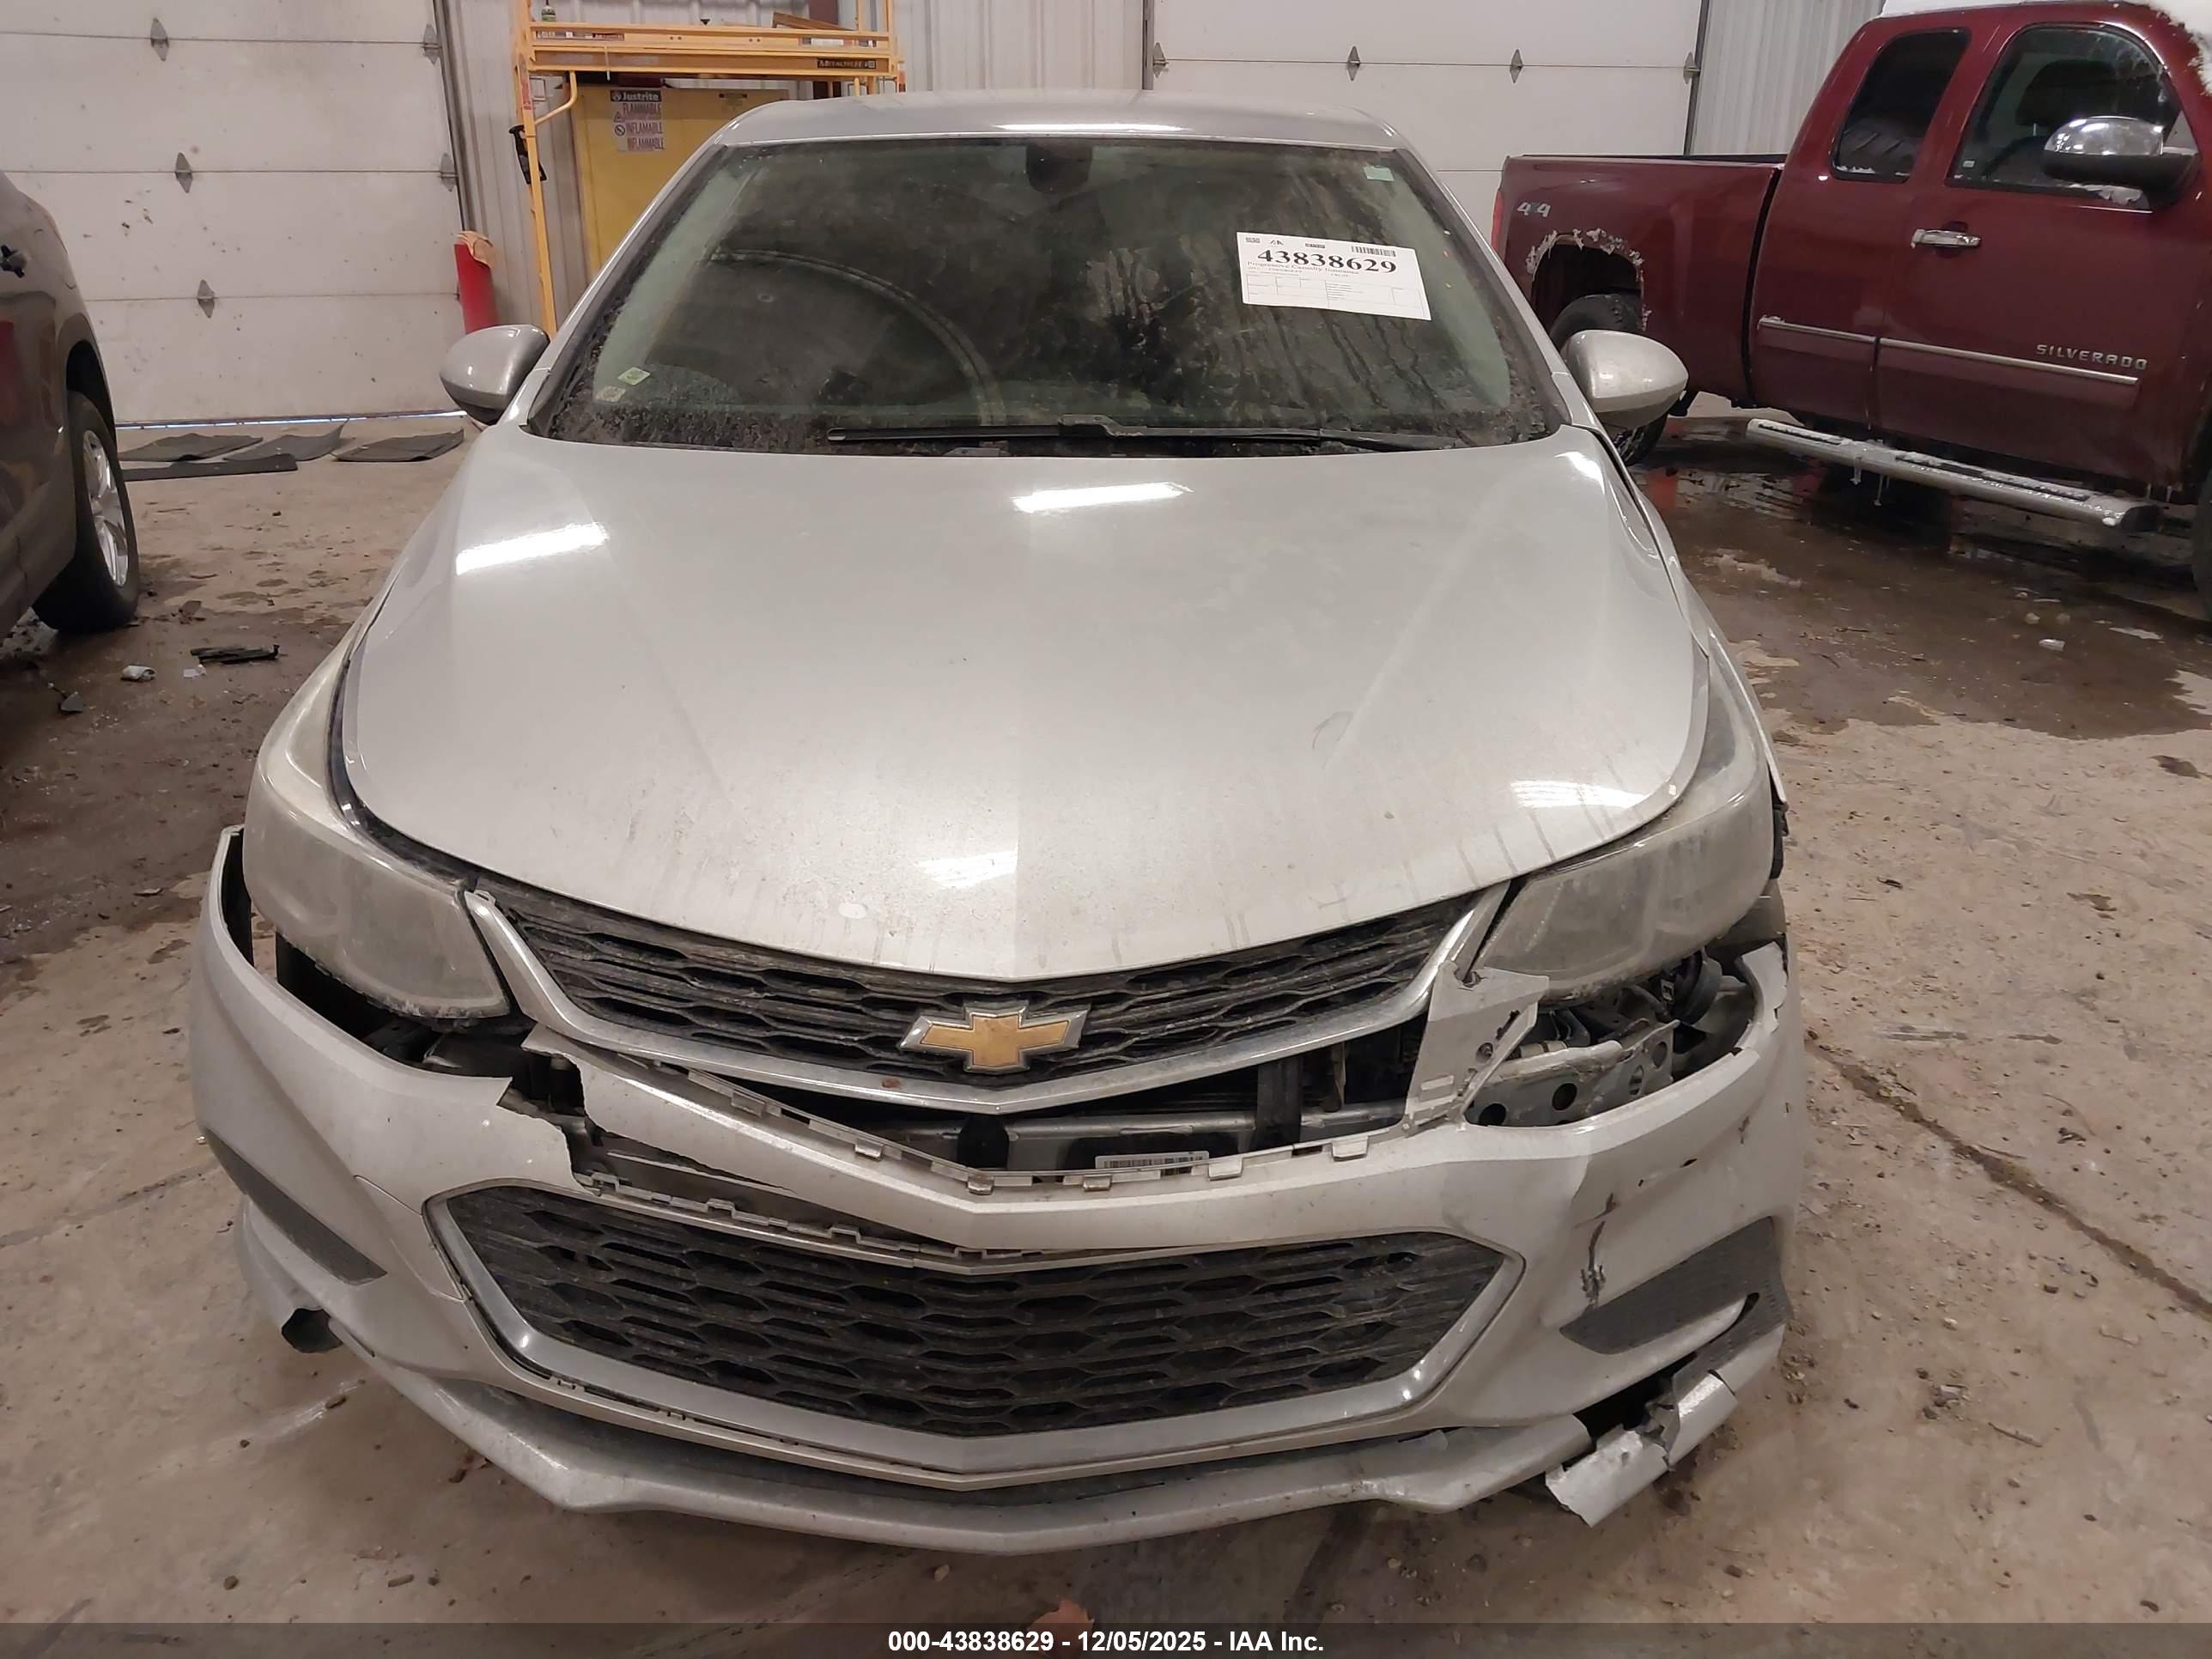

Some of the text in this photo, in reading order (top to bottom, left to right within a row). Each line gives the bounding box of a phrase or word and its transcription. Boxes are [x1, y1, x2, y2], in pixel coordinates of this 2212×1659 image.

[623, 91, 659, 101] Justrite
[1247, 260, 1289, 270] Progressive
[1257, 249, 1396, 274] 43838629
[2036, 343, 2148, 370] SILVERADO
